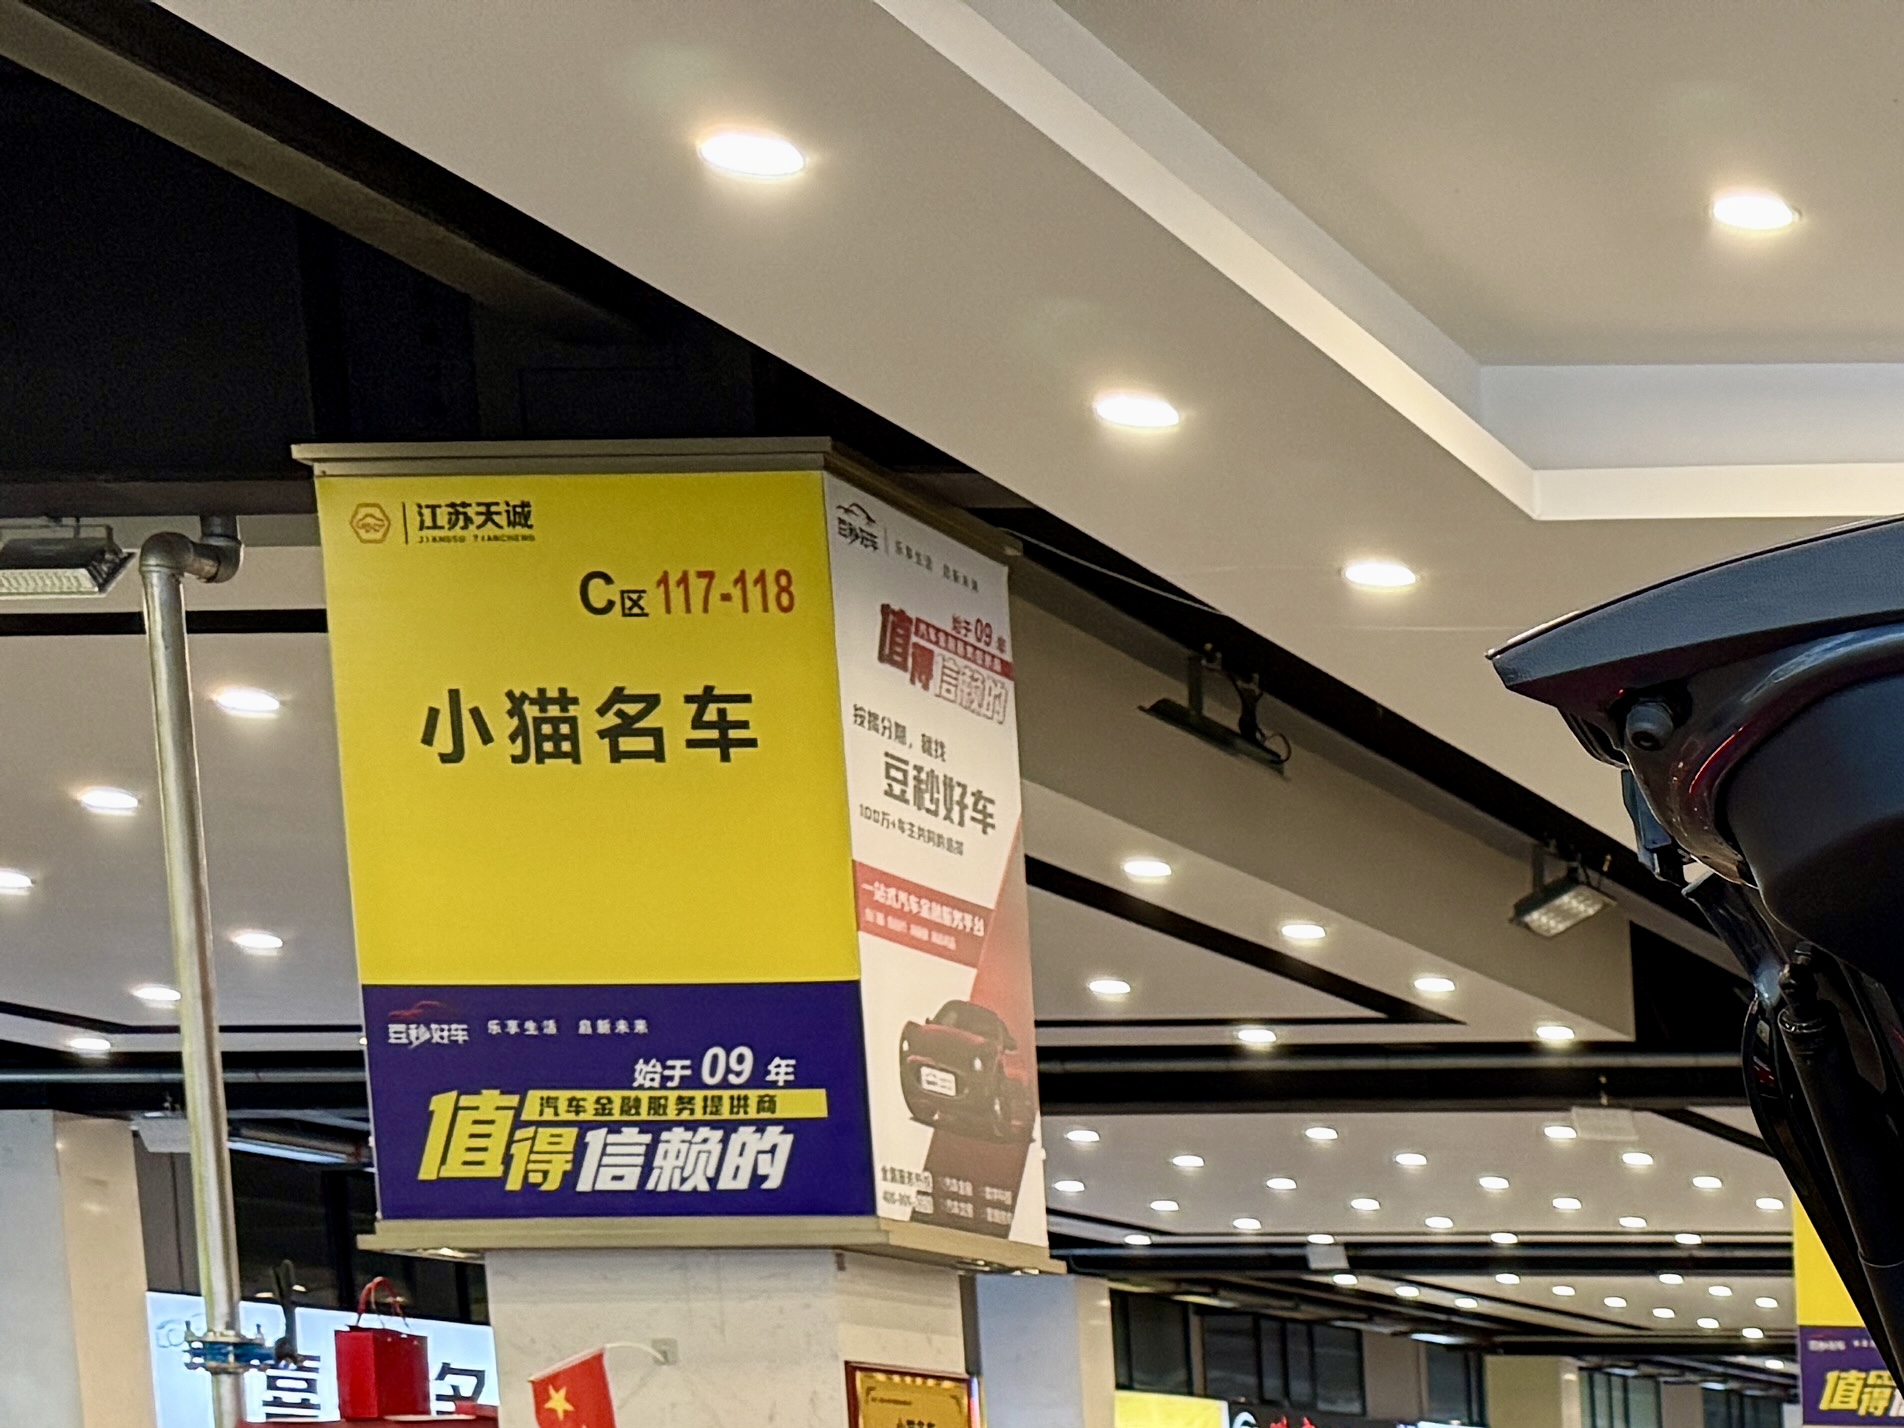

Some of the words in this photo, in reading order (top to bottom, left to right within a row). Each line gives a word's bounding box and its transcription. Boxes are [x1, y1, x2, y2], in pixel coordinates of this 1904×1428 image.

[415, 500, 534, 532] 江苏天诚
[420, 685, 758, 765] 小猫名车
[884, 751, 996, 836] 豆秒好车
[388, 1023, 469, 1048] 豆秒好车
[487, 1019, 559, 1035] 乐享生活
[632, 1045, 796, 1089] 始于09年
[538, 1093, 779, 1118] 汽车金融服务提供商
[417, 1089, 794, 1193] 值得信赖的
